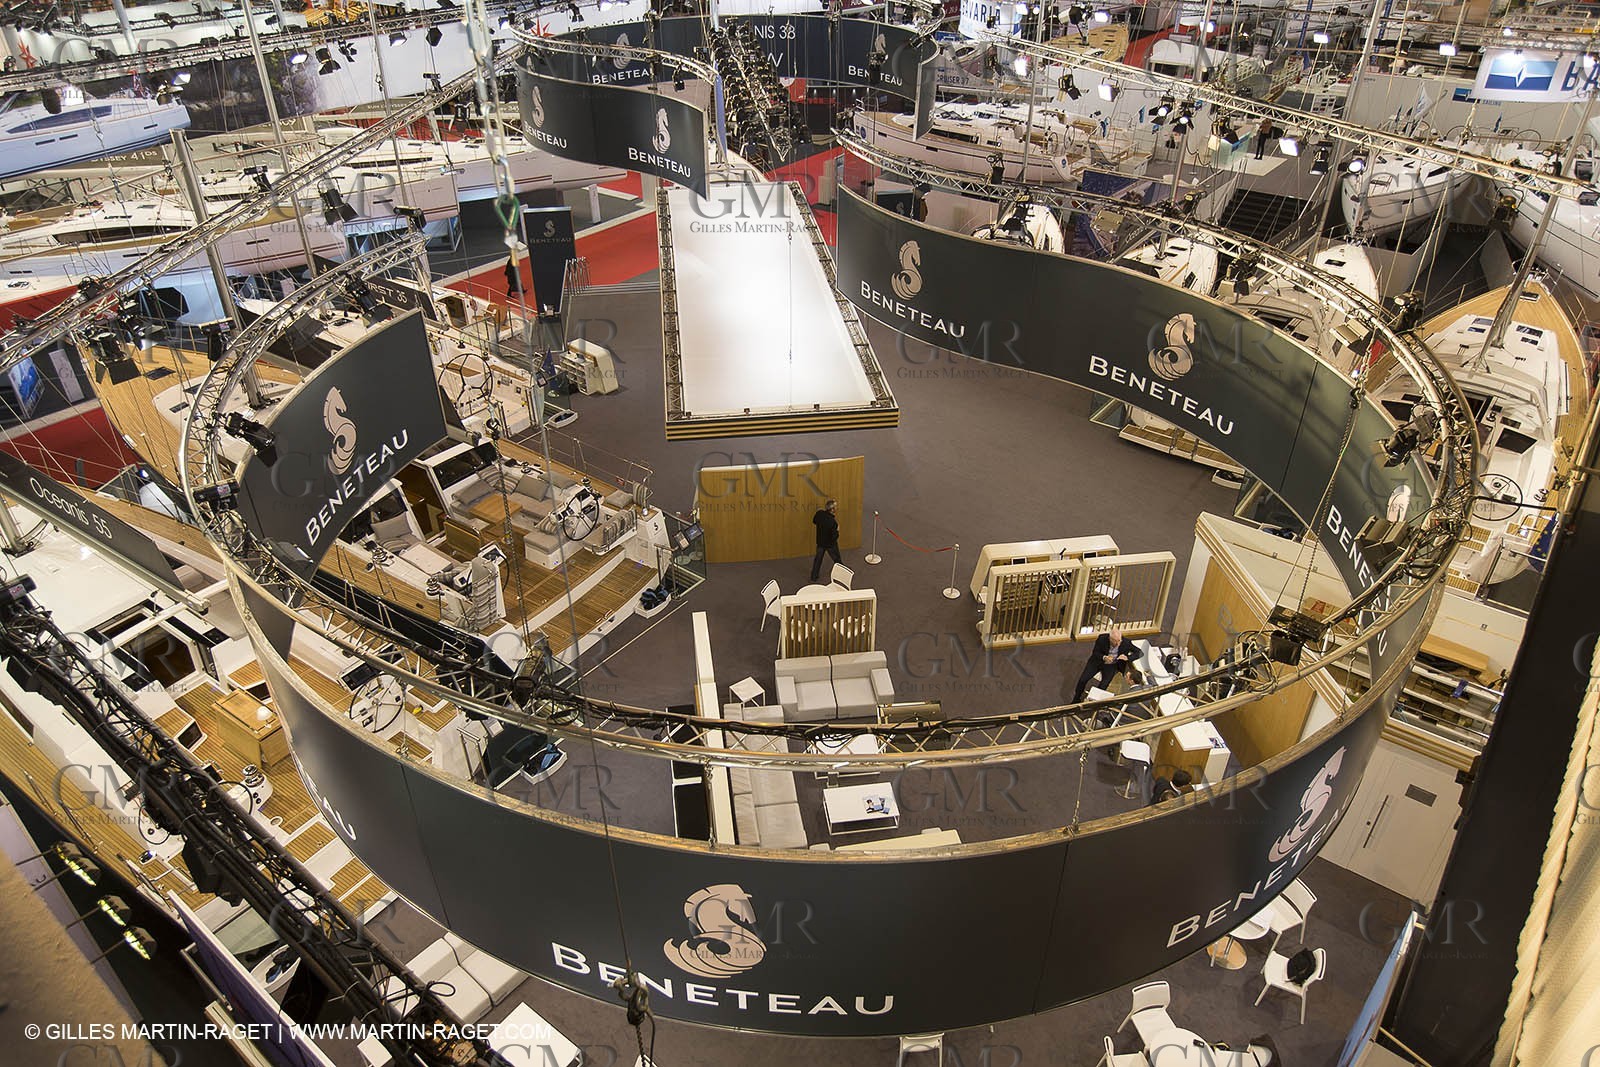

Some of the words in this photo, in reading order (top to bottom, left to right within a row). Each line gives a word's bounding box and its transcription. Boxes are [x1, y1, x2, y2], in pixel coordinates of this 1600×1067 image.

[779, 25, 796, 39] 38
[848, 65, 903, 86] BENTEAU
[628, 147, 692, 178] BENETEAU
[861, 280, 965, 338] BENETEAU
[1089, 355, 1234, 435] BENETEAU
[29, 477, 90, 526] Oceanis
[92, 513, 113, 539] 55
[305, 429, 409, 546] BENETEAU
[551, 942, 895, 1016] BENETEAU
